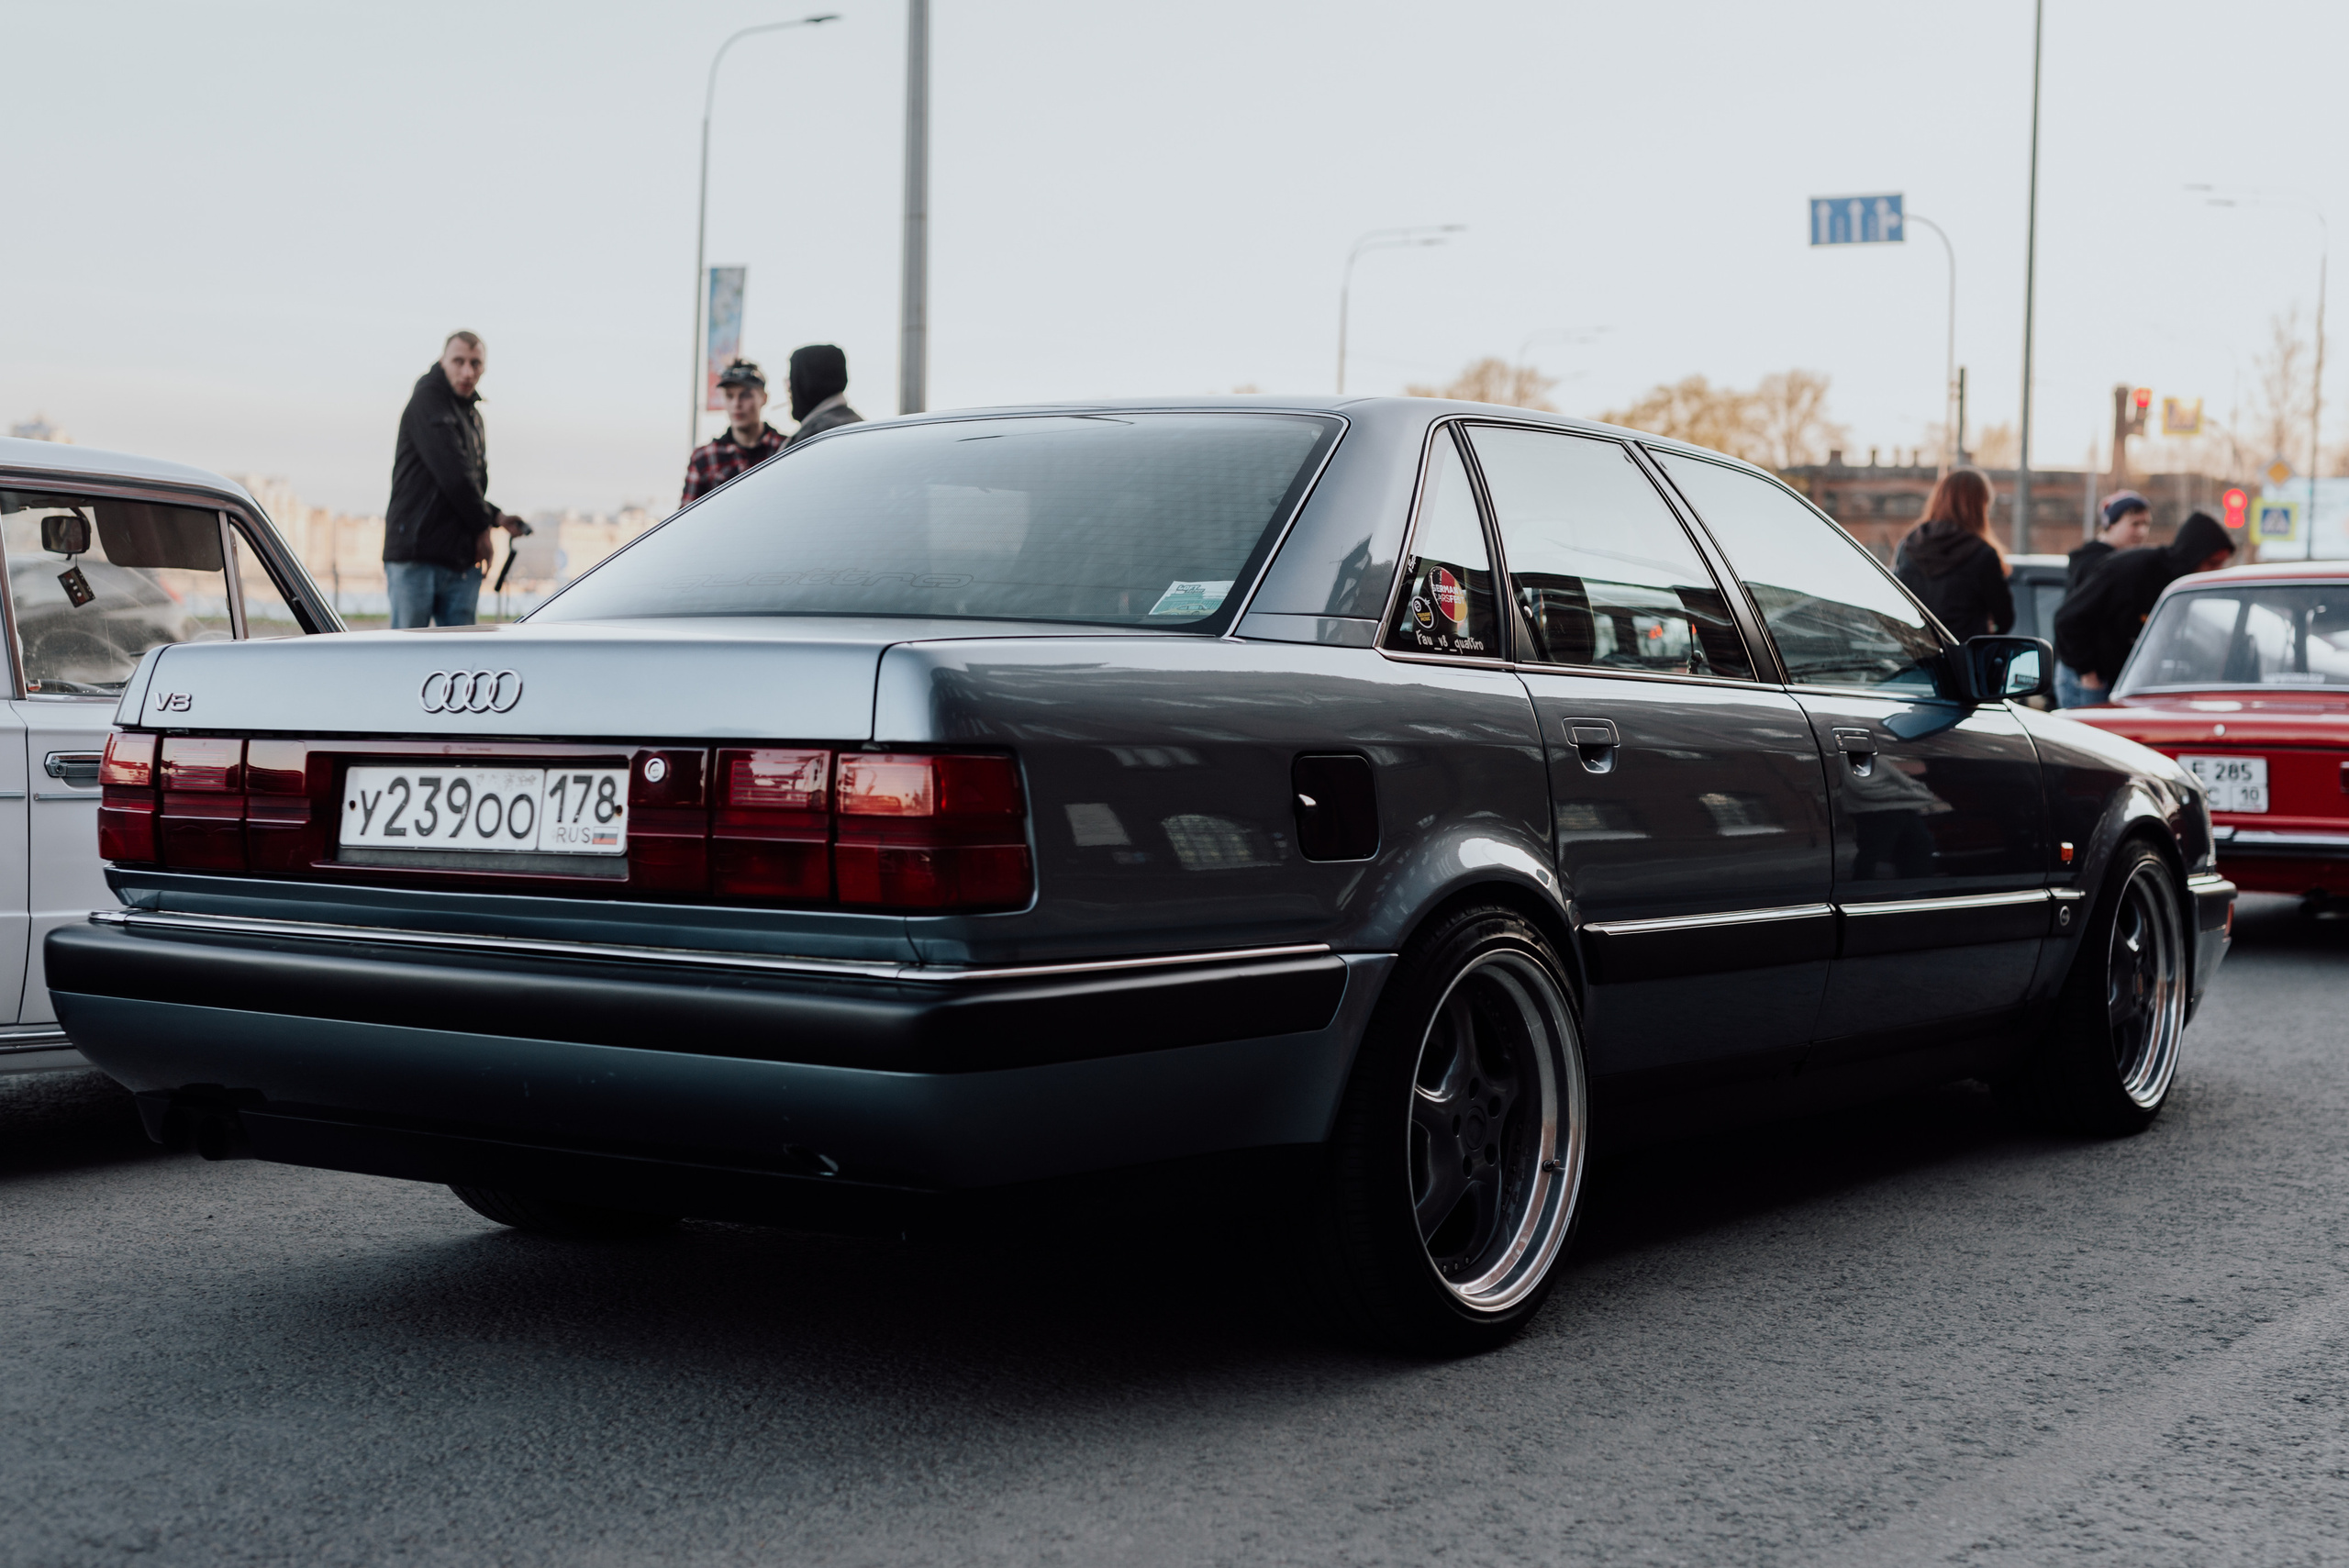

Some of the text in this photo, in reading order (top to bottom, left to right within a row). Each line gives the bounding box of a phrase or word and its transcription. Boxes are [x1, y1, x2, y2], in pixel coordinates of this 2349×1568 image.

[662, 567, 974, 594] quattro
[154, 693, 192, 712] V8
[2215, 761, 2253, 781] 285
[549, 774, 617, 823] 178
[2241, 786, 2259, 803] 10
[556, 827, 591, 844] RUS
